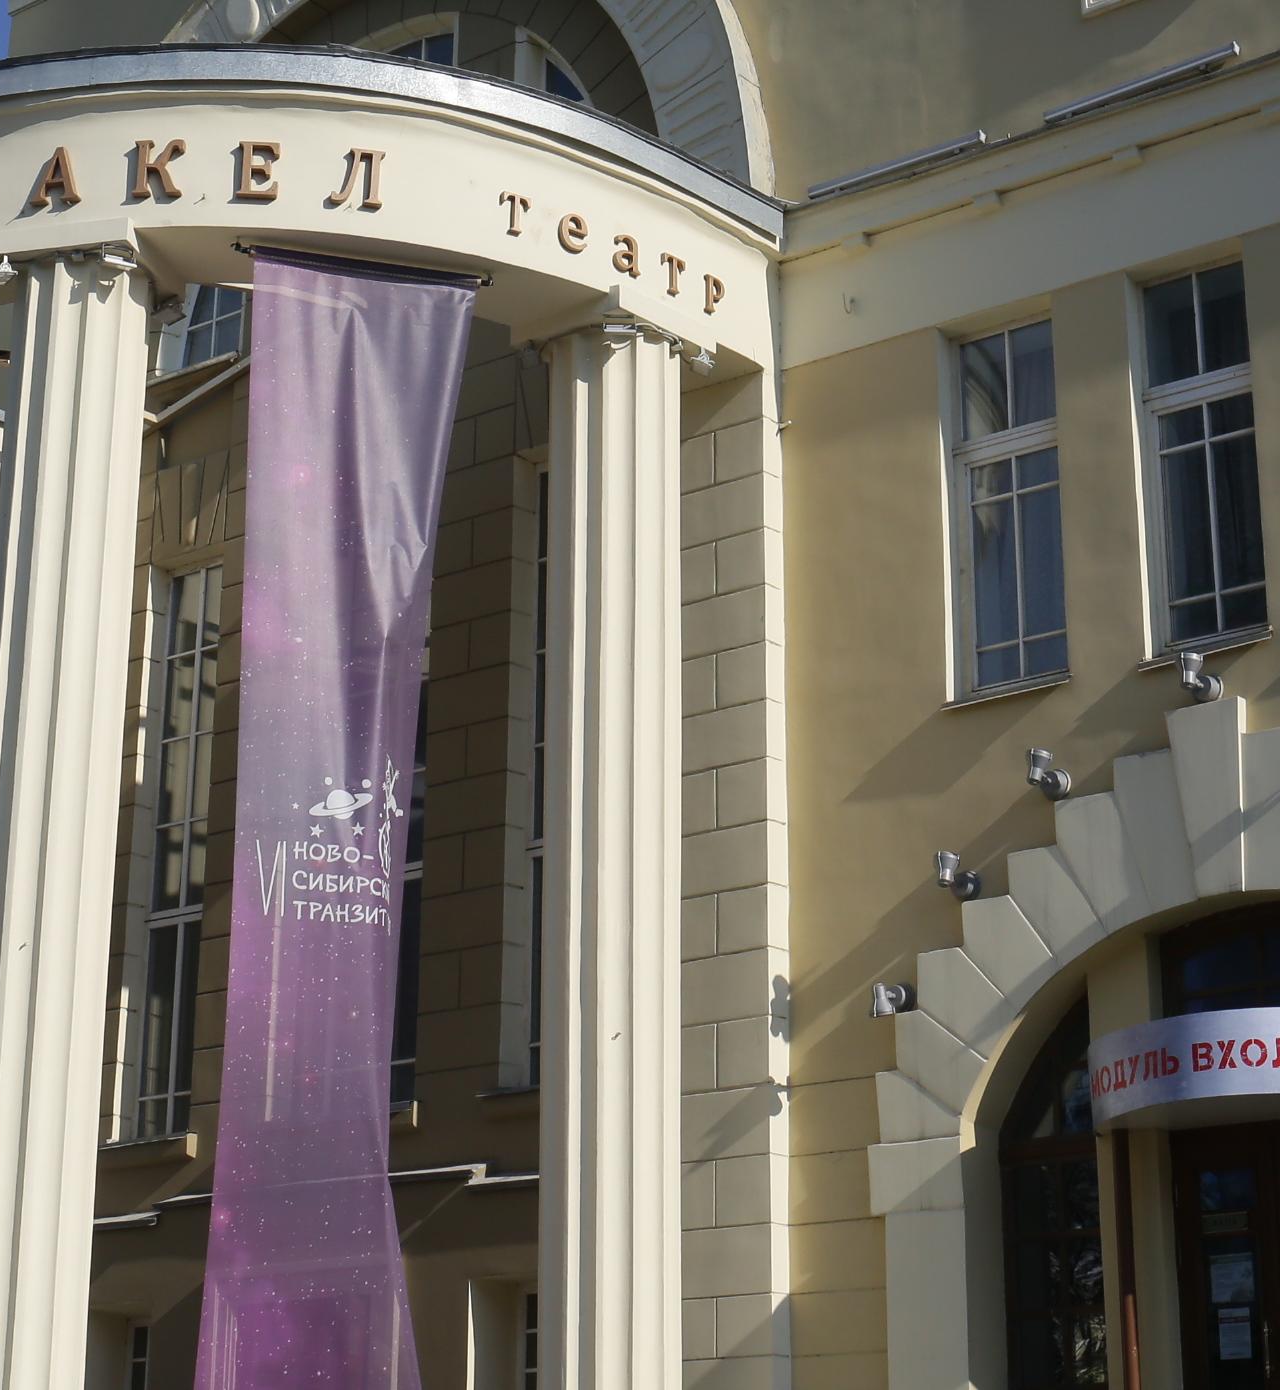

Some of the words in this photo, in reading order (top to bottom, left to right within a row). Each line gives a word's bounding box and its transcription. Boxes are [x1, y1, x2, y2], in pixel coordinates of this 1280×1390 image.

[292, 840, 375, 863] НОВО-
[292, 869, 390, 900] СИБИРСК
[292, 900, 388, 927] ТРАНЗИТ
[1091, 1047, 1180, 1098] МОДУЛЬ
